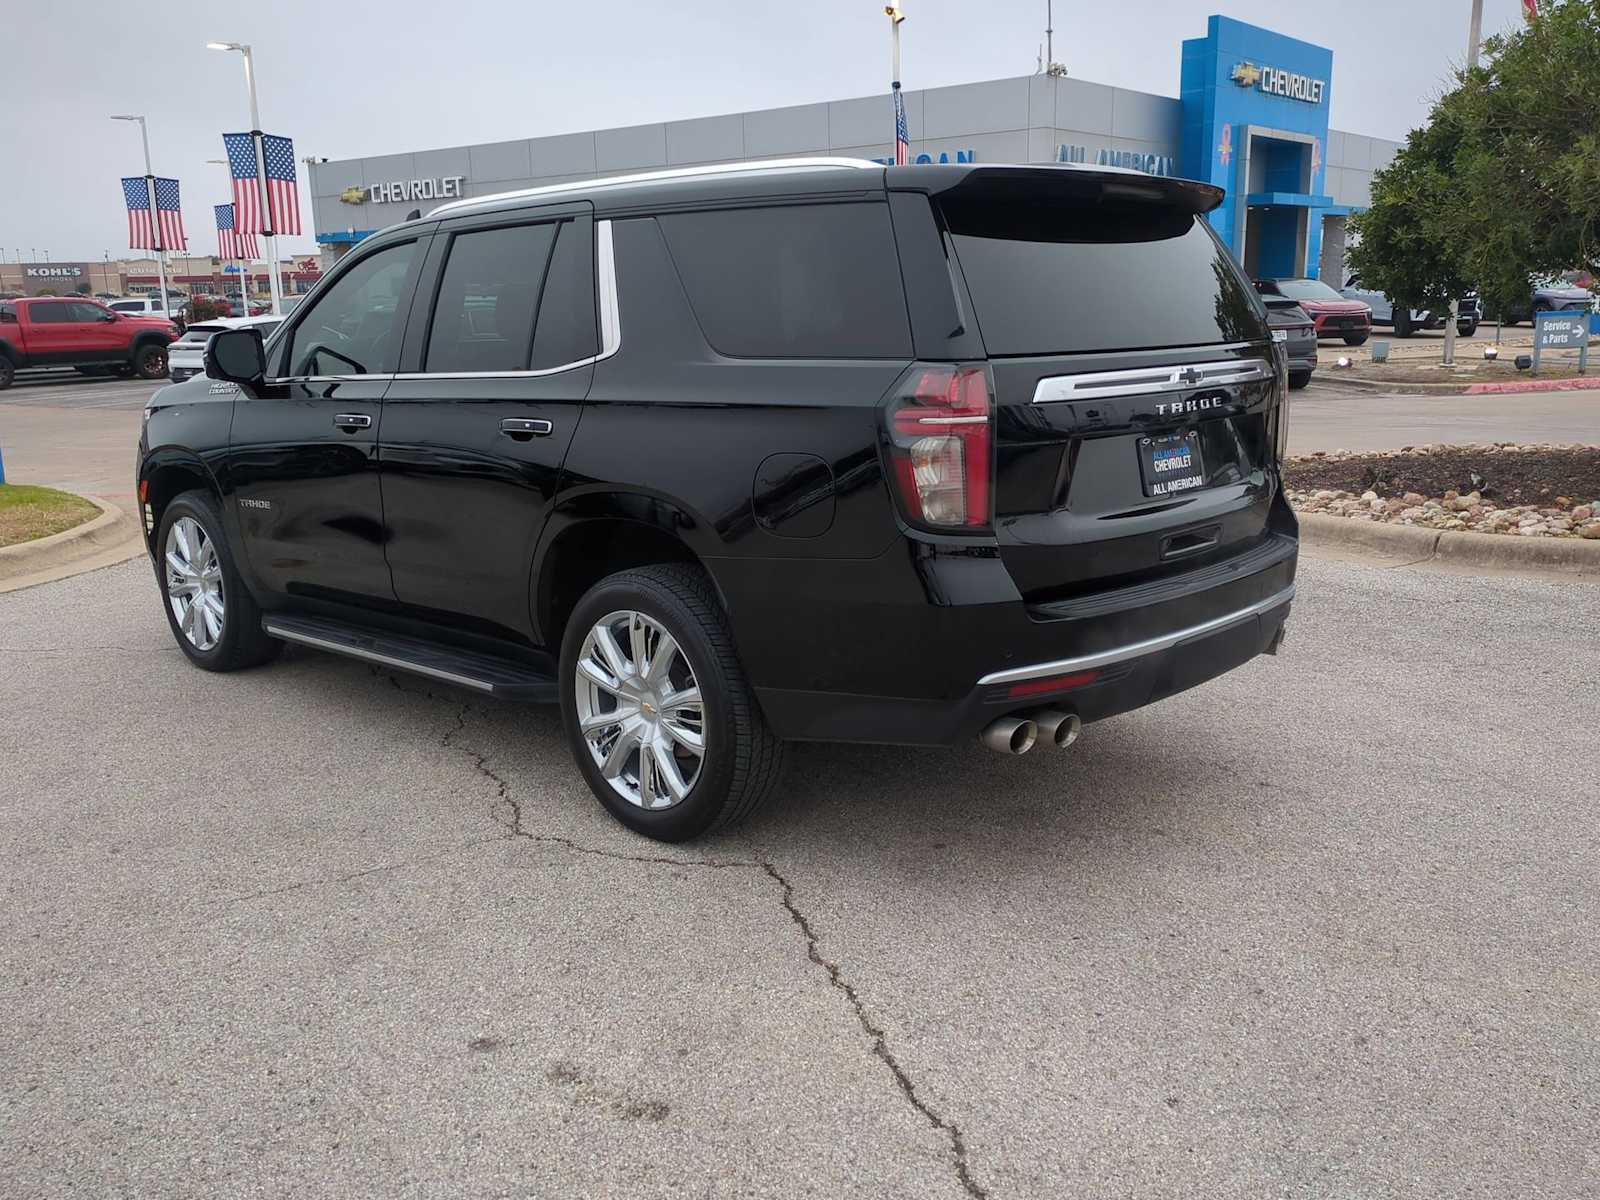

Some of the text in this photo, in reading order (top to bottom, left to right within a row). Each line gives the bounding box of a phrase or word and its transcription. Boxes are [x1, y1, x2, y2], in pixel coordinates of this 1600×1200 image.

[1262, 66, 1325, 103] CHEVROLET
[1056, 144, 1174, 176] ALL AMERICAN
[371, 176, 463, 203] CHEVROLET
[27, 268, 81, 276] KOHL'S
[1543, 320, 1571, 331] Service
[1549, 334, 1568, 343] Parts
[1156, 397, 1222, 415] TAHOE
[1154, 455, 1191, 472] CHEVROLET
[1153, 475, 1202, 495] ALL AMERICAN
[240, 499, 270, 509] TAHOE
